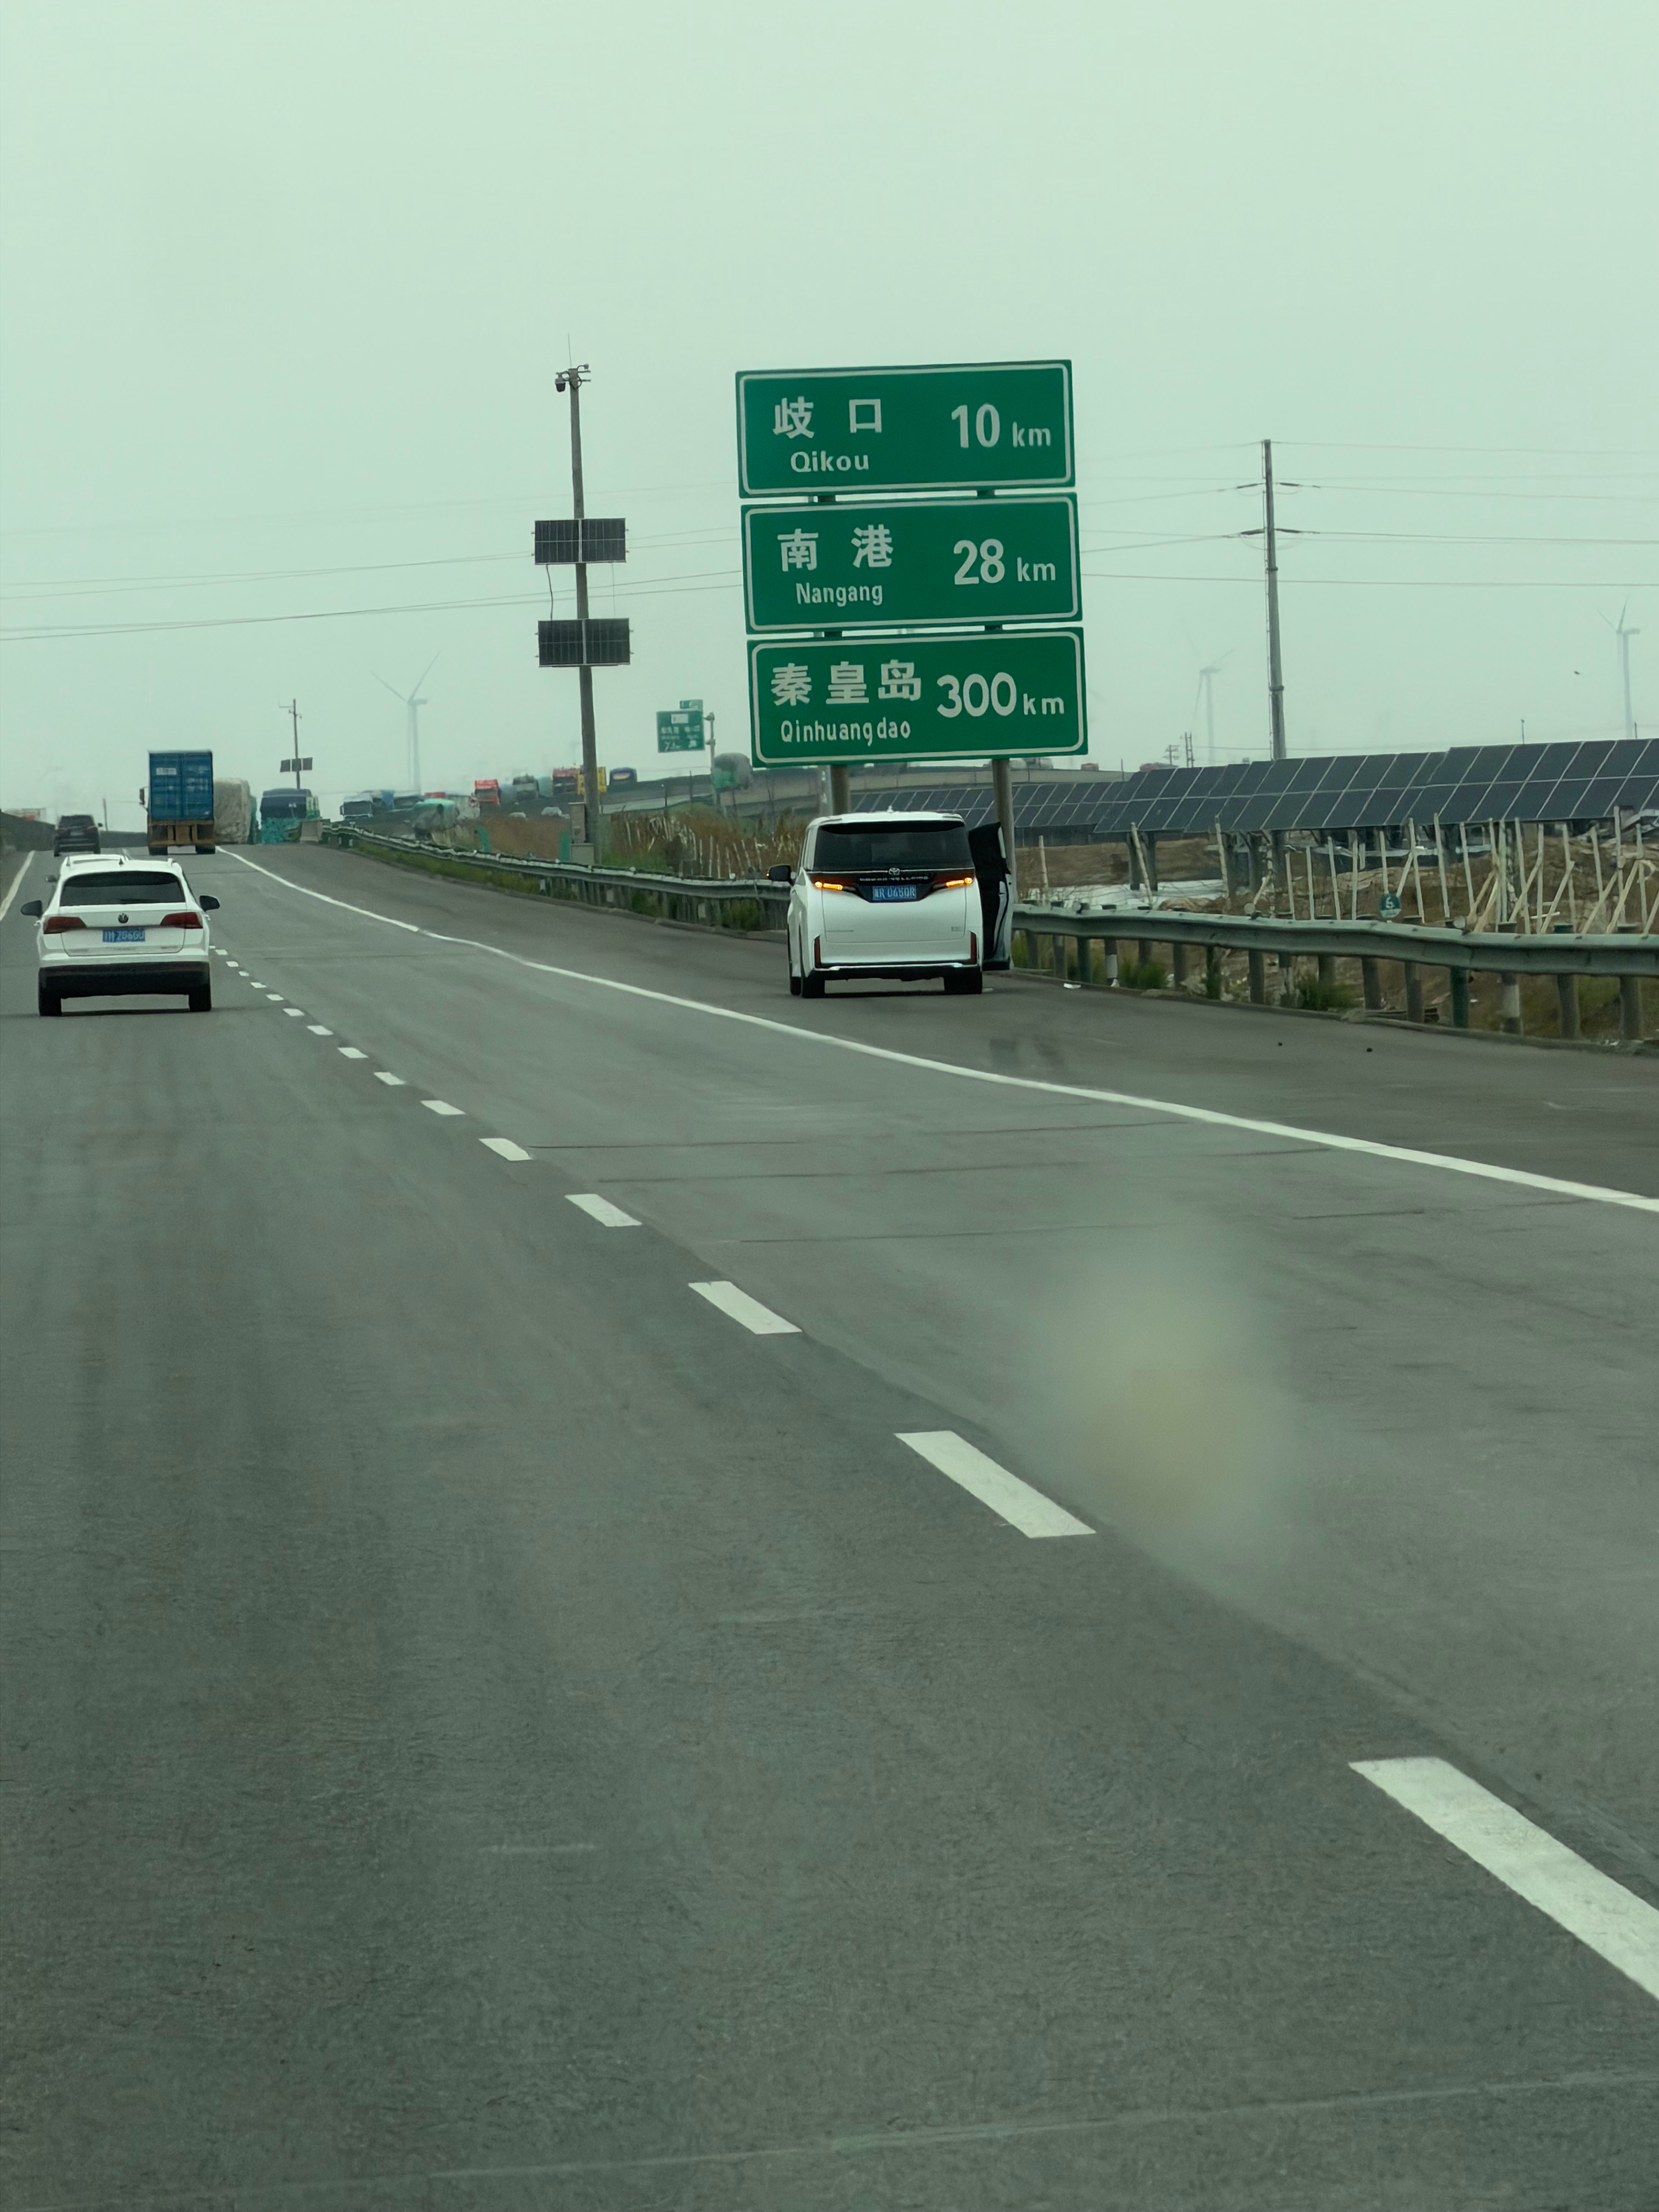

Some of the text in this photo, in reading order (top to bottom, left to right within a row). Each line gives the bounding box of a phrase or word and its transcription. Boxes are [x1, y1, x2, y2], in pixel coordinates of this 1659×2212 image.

[772, 396, 1051, 449] 歧口 10 km
[790, 450, 870, 473] Qikou
[777, 524, 1056, 585] 南港 28 km
[795, 582, 883, 607] Nangang
[770, 659, 1065, 719] 秦皇岛 300 km
[780, 716, 911, 747] Qinhuangdao
